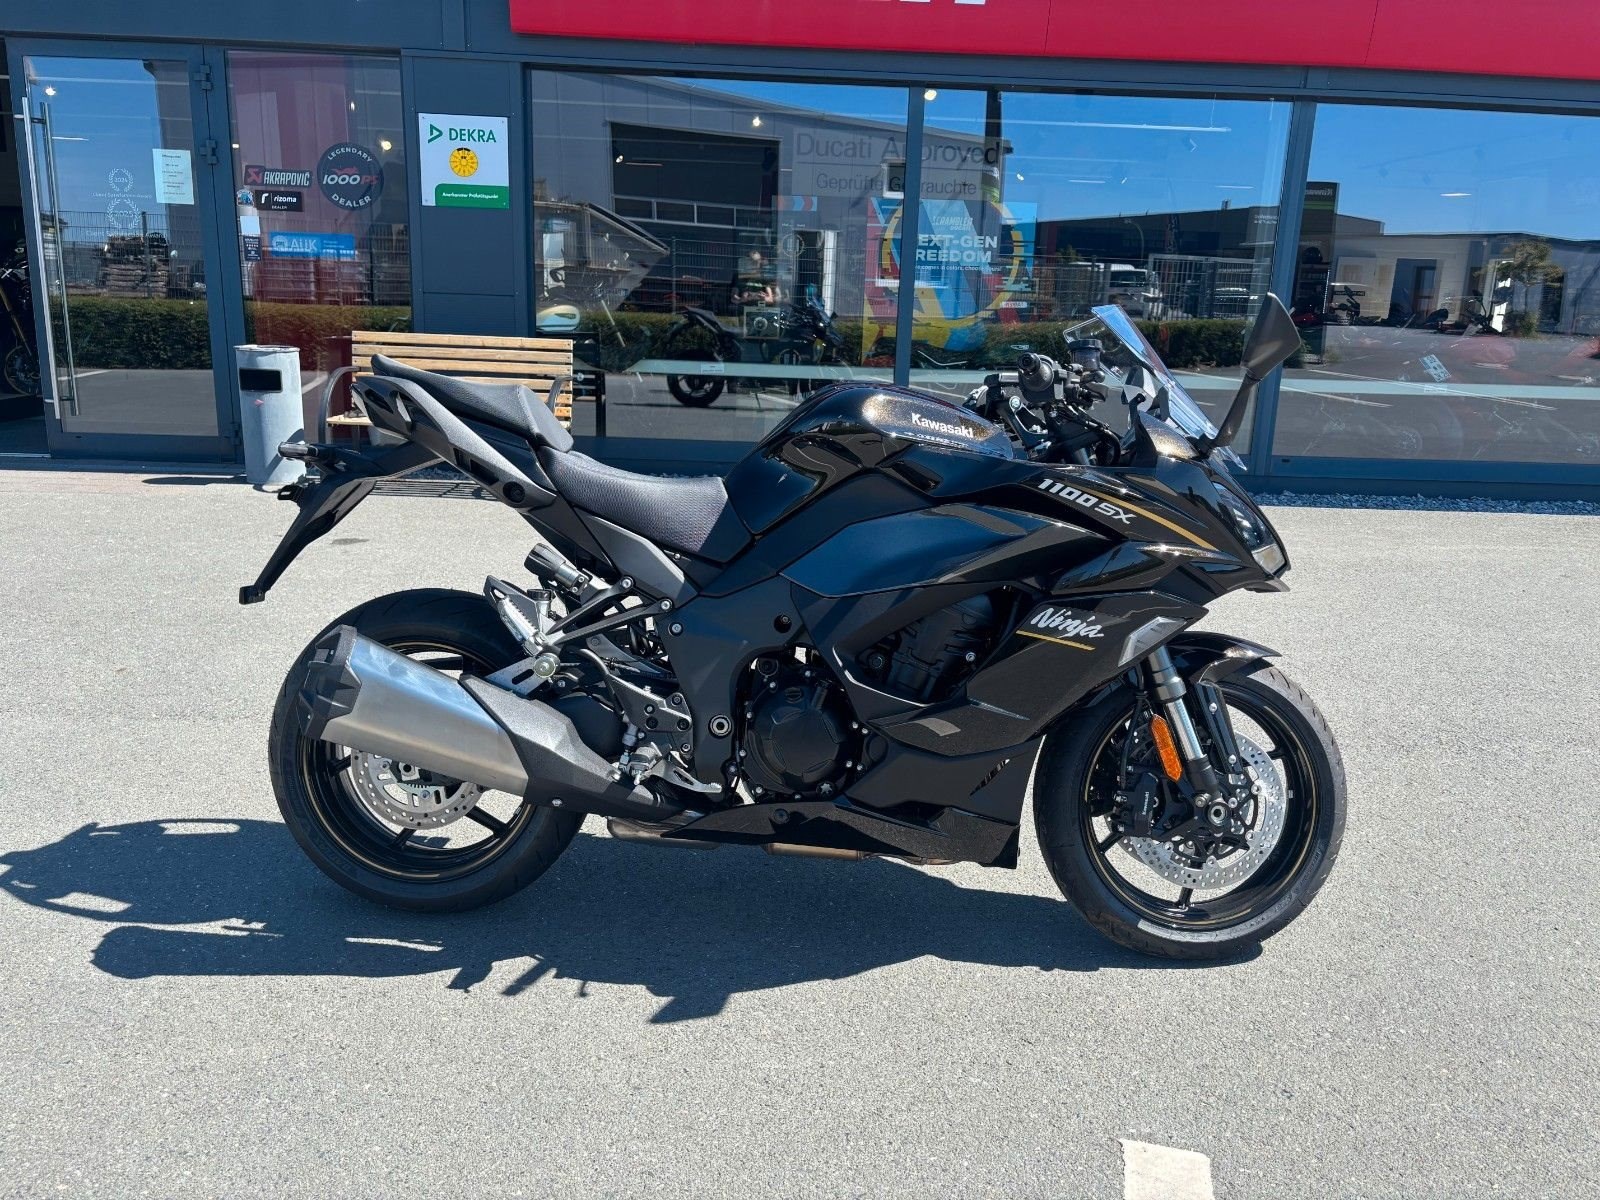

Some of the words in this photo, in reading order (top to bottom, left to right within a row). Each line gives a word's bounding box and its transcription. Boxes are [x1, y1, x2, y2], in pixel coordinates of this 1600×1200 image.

[448, 127, 497, 143] DEKRA
[796, 133, 872, 159] Ducati
[327, 146, 373, 163] LEGENDARY
[815, 172, 884, 193] Geprüfte
[890, 176, 977, 195] Grauchte
[273, 195, 297, 203] rizoma
[331, 193, 372, 208] DEALER
[932, 215, 974, 227] SCRAMBLER
[917, 233, 998, 249] EXT-GEN
[915, 248, 992, 263] REEDOM
[911, 412, 974, 439] Kawasaki
[1030, 607, 1105, 639] Ninja
